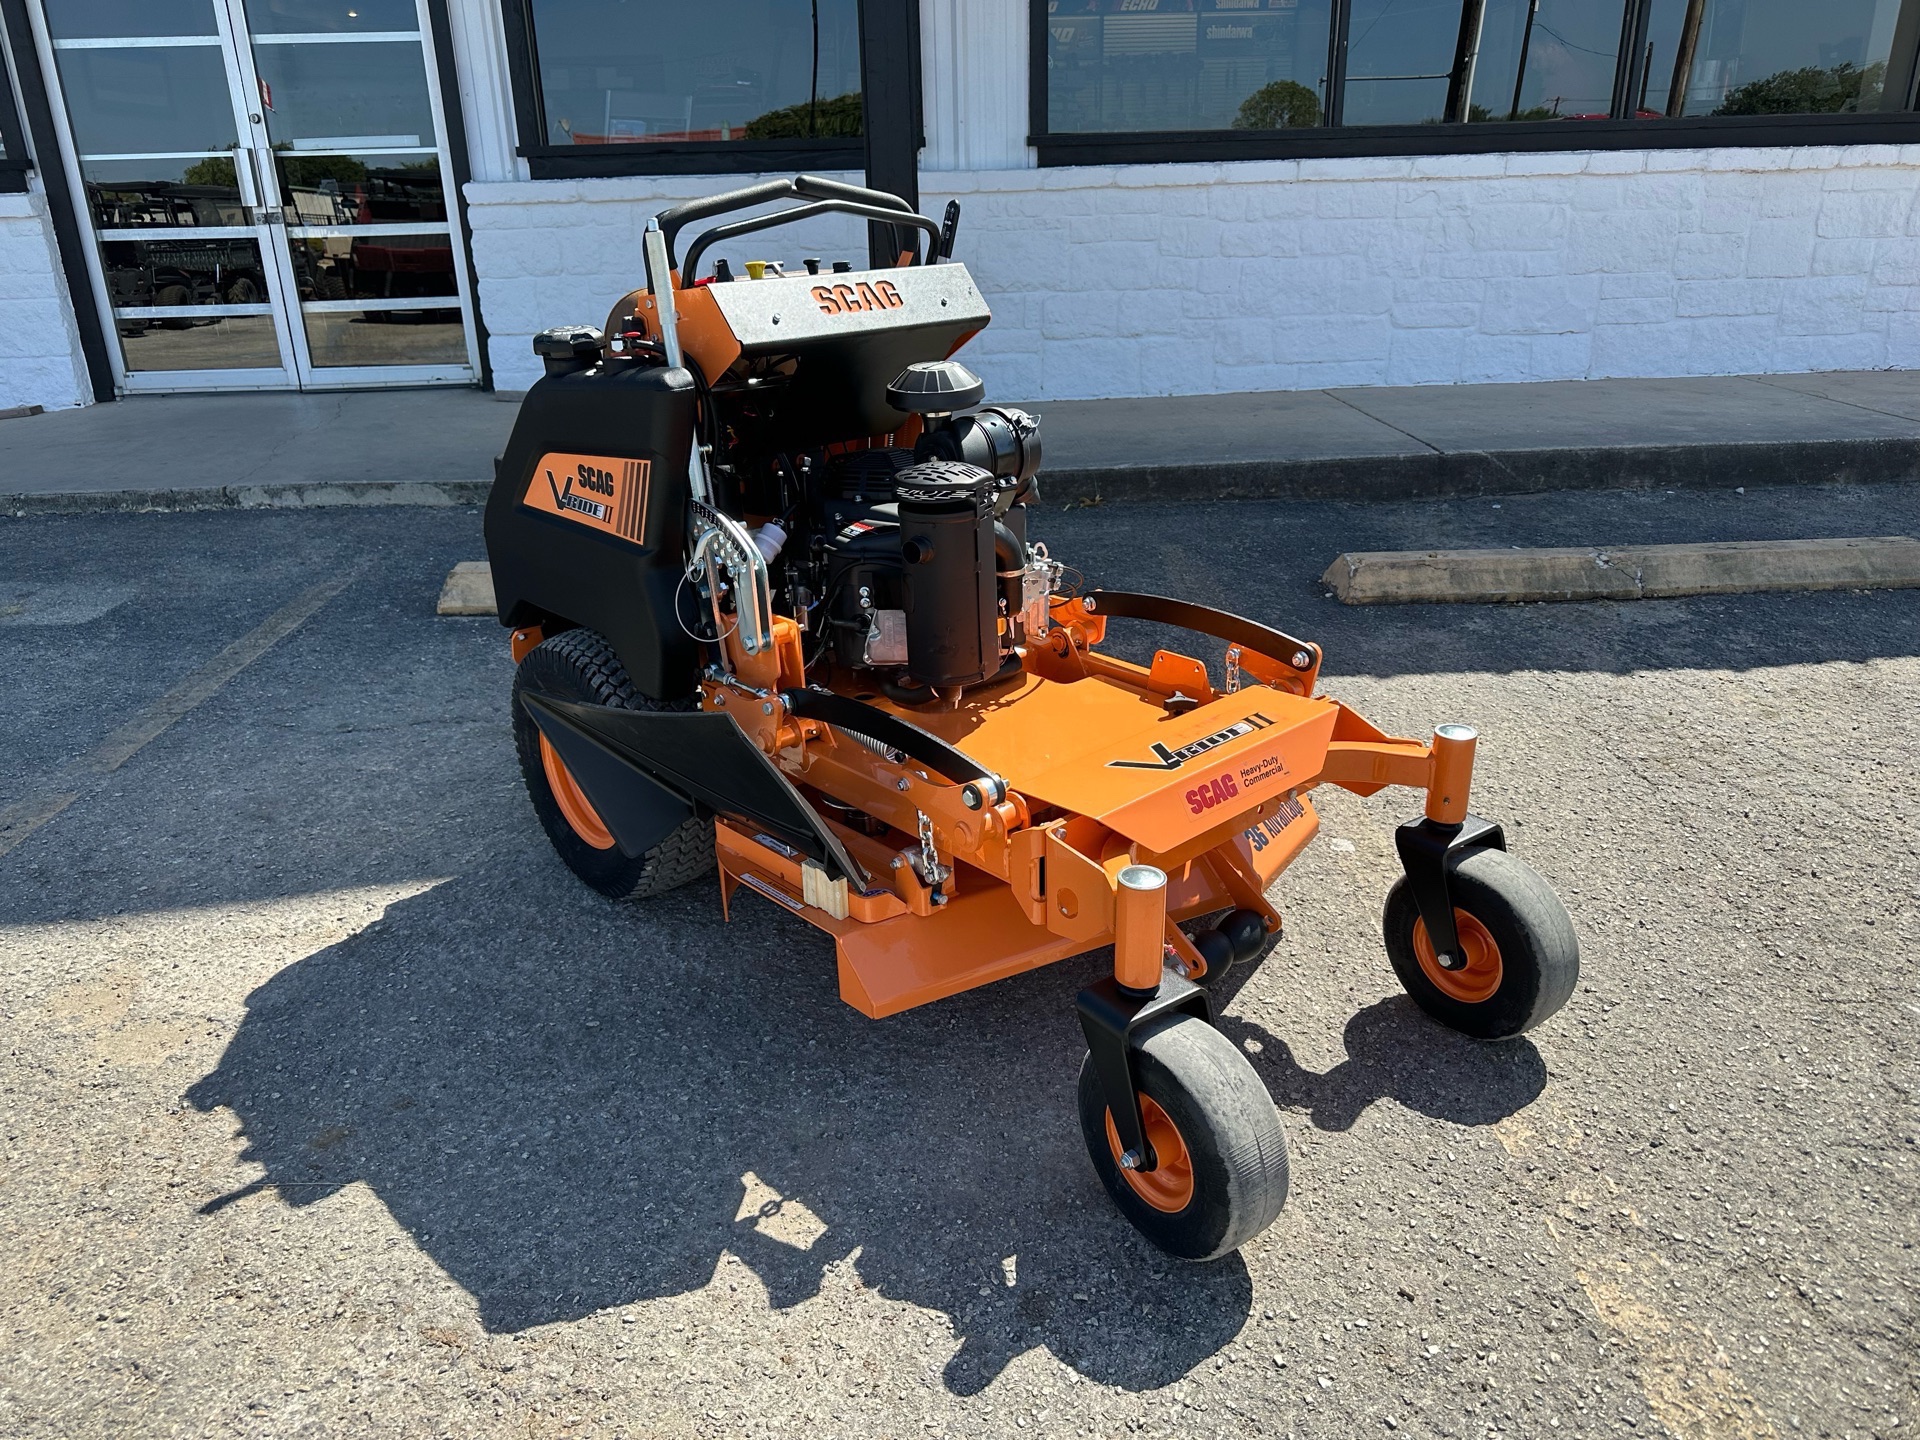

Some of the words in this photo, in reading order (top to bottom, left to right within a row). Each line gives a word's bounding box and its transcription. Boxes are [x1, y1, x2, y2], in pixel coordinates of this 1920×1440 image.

[1206, 25, 1253, 39] shindaiwa
[810, 280, 904, 315] SCAG
[577, 463, 614, 497] SCAG
[1240, 754, 1279, 779] Heavy-Duty
[1243, 764, 1284, 788] Commercial
[1185, 773, 1239, 814] SCAG
[1244, 825, 1270, 852] 36
